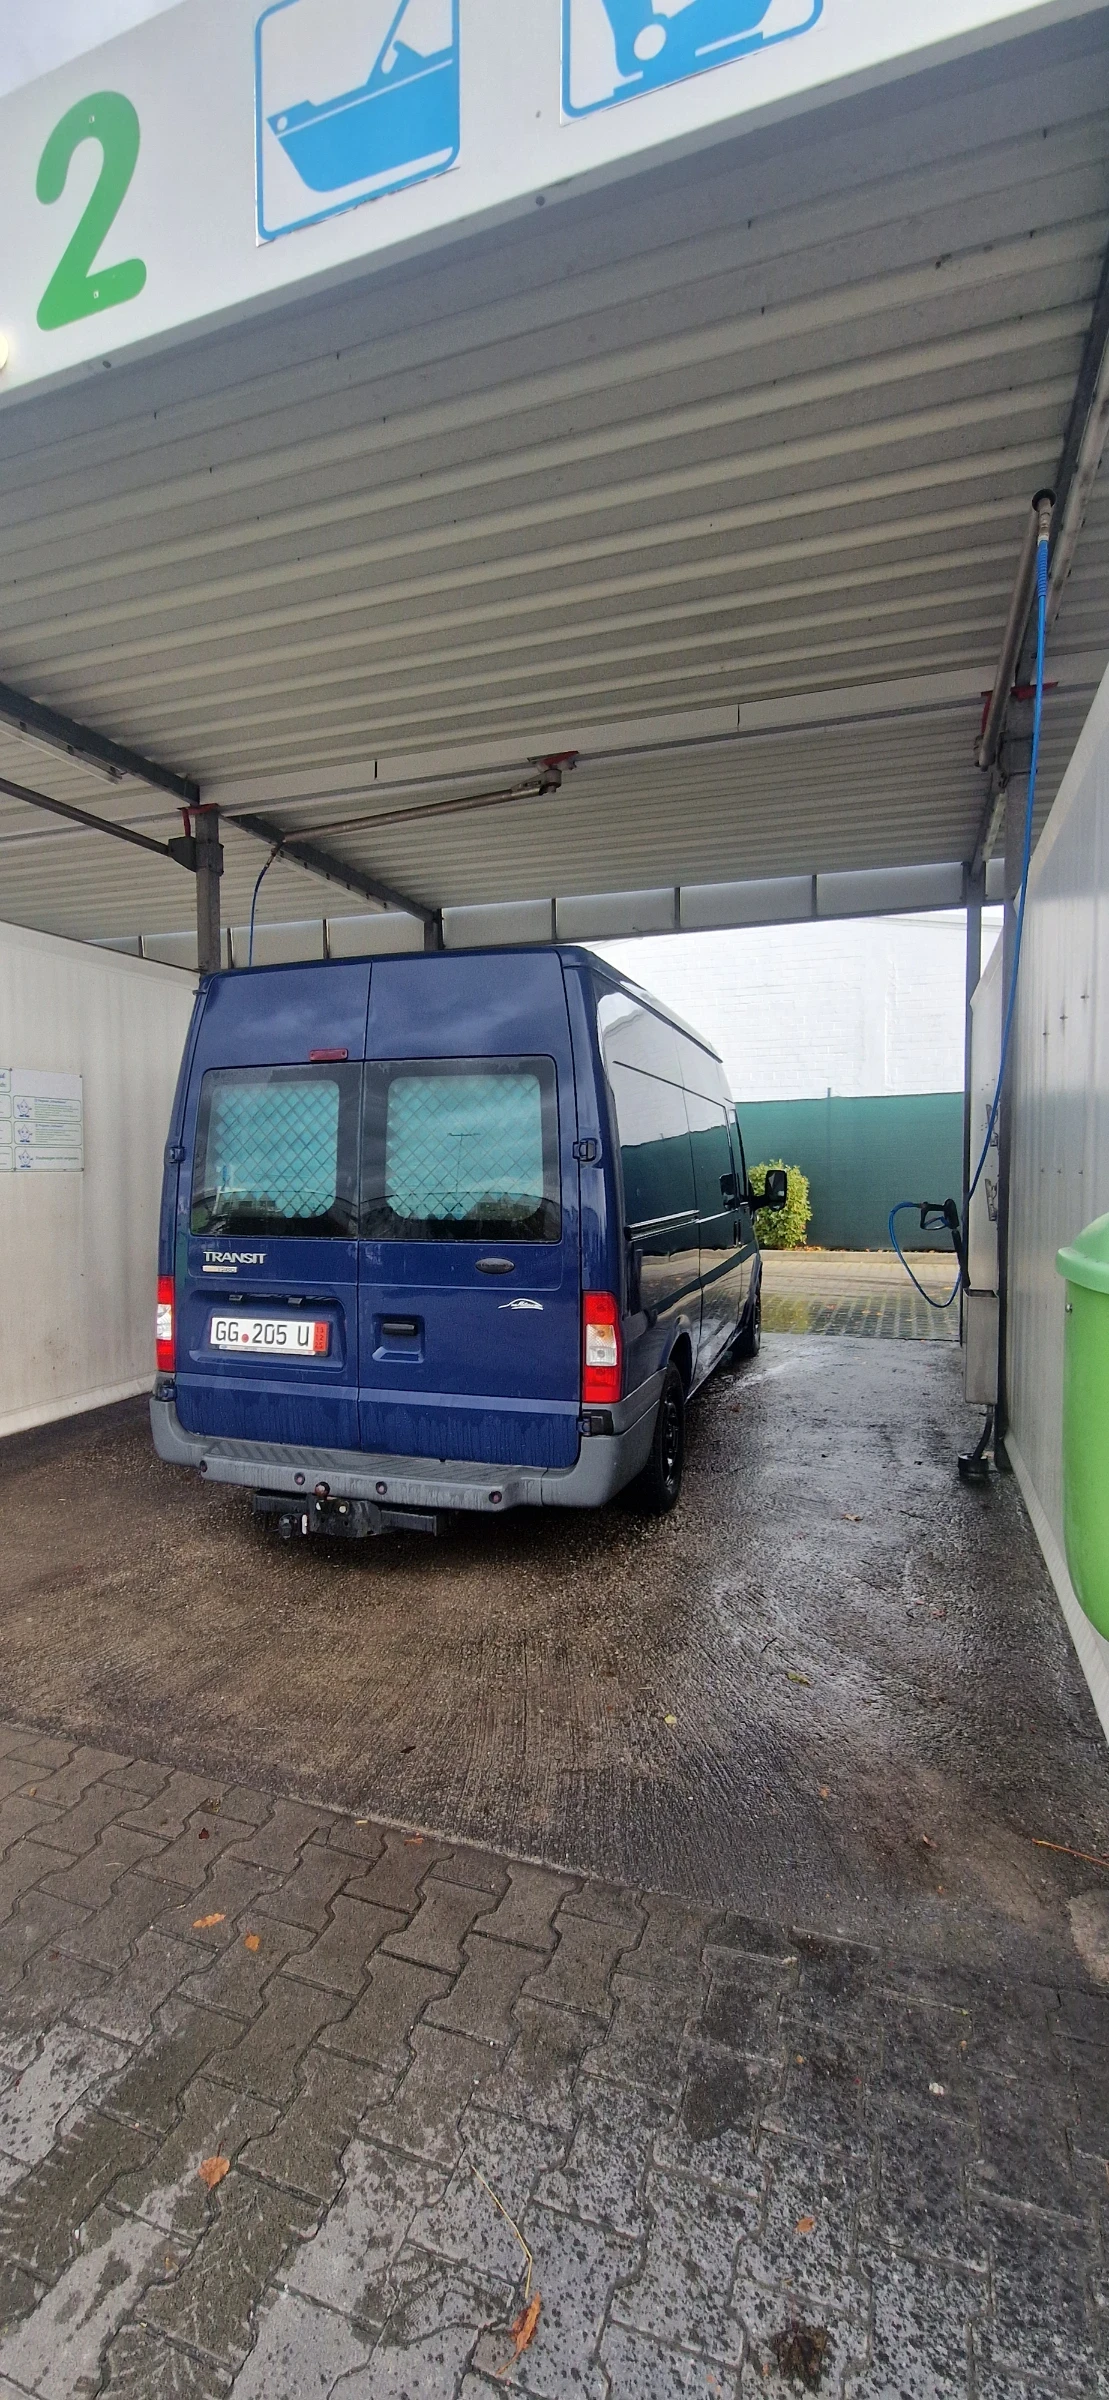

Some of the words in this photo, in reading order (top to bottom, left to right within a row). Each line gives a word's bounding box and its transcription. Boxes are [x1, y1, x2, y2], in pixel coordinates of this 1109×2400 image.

[35, 89, 148, 332] 2
[203, 1251, 267, 1264] TRANSIT
[215, 1321, 239, 1342] GG
[252, 1323, 288, 1345] 205
[297, 1325, 310, 1347] U
